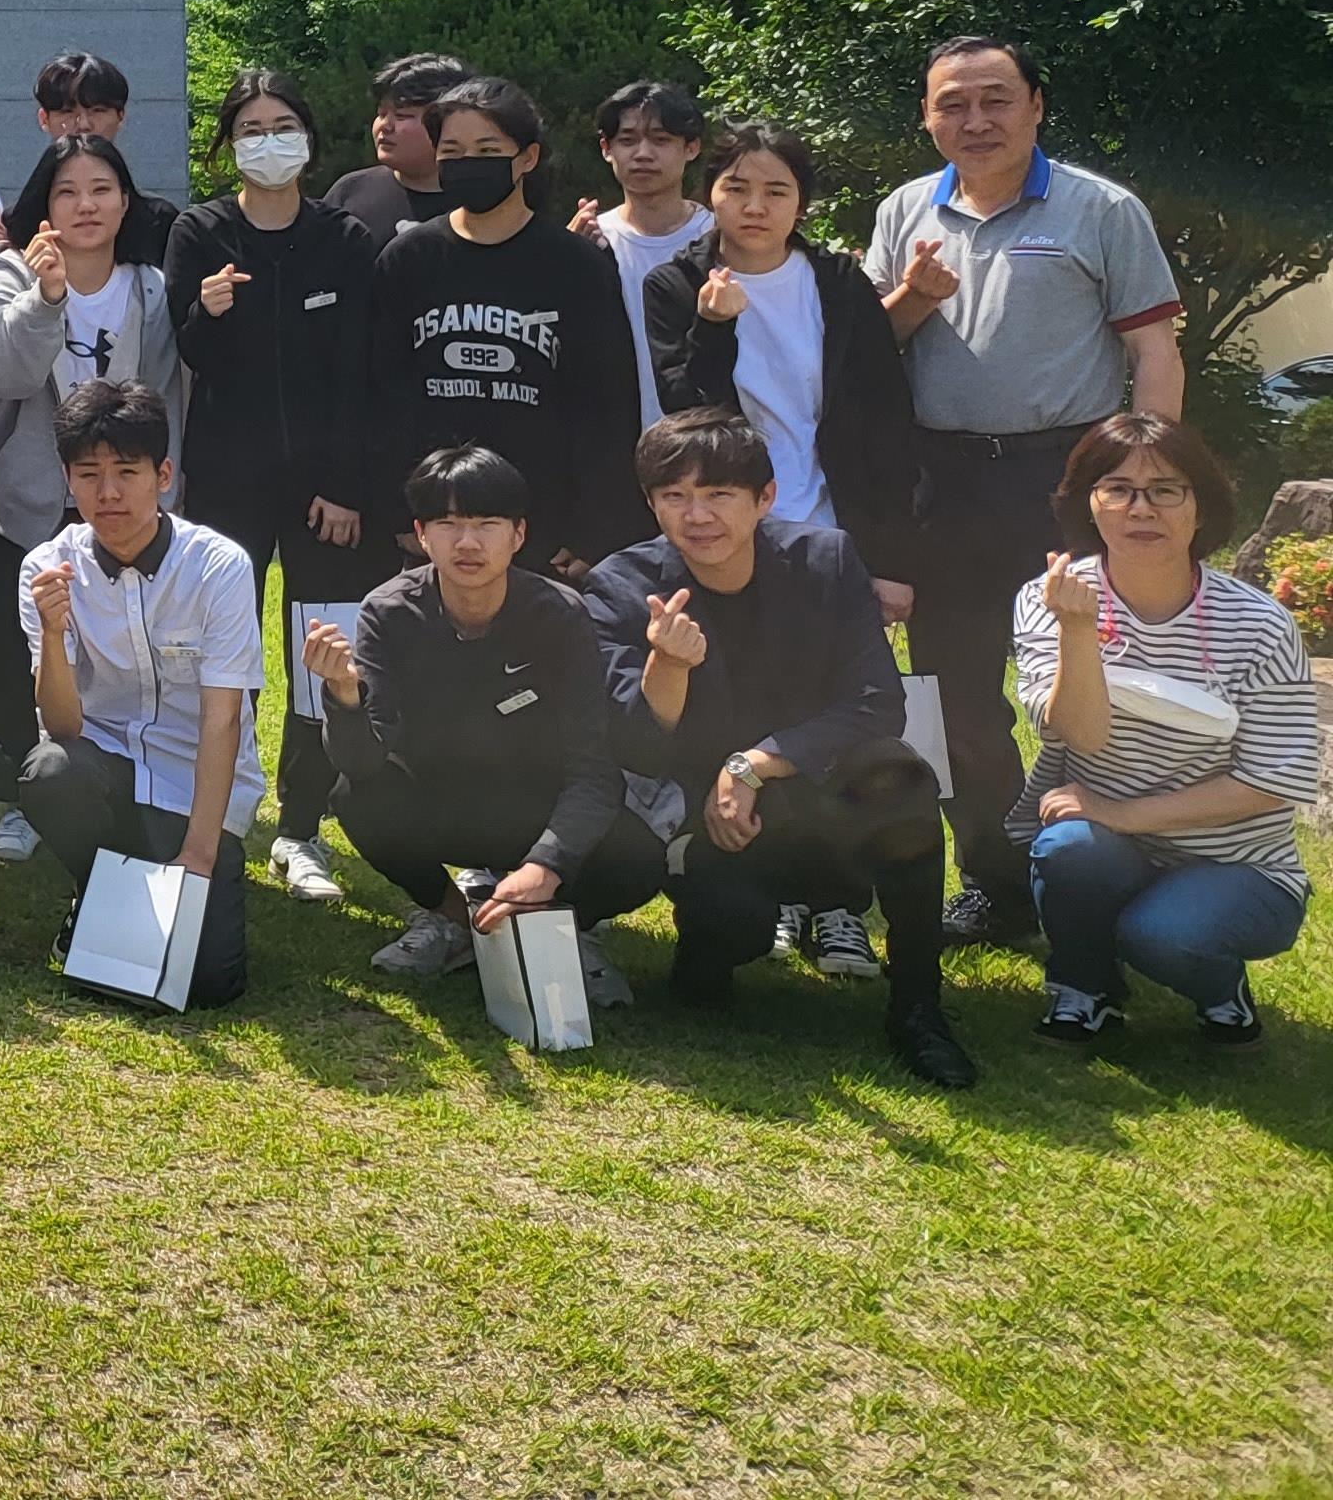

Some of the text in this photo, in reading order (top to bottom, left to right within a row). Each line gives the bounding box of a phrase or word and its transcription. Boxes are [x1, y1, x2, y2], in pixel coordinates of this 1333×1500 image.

[460, 346, 499, 367] 992
[426, 378, 539, 407] SCHOOL MADE
